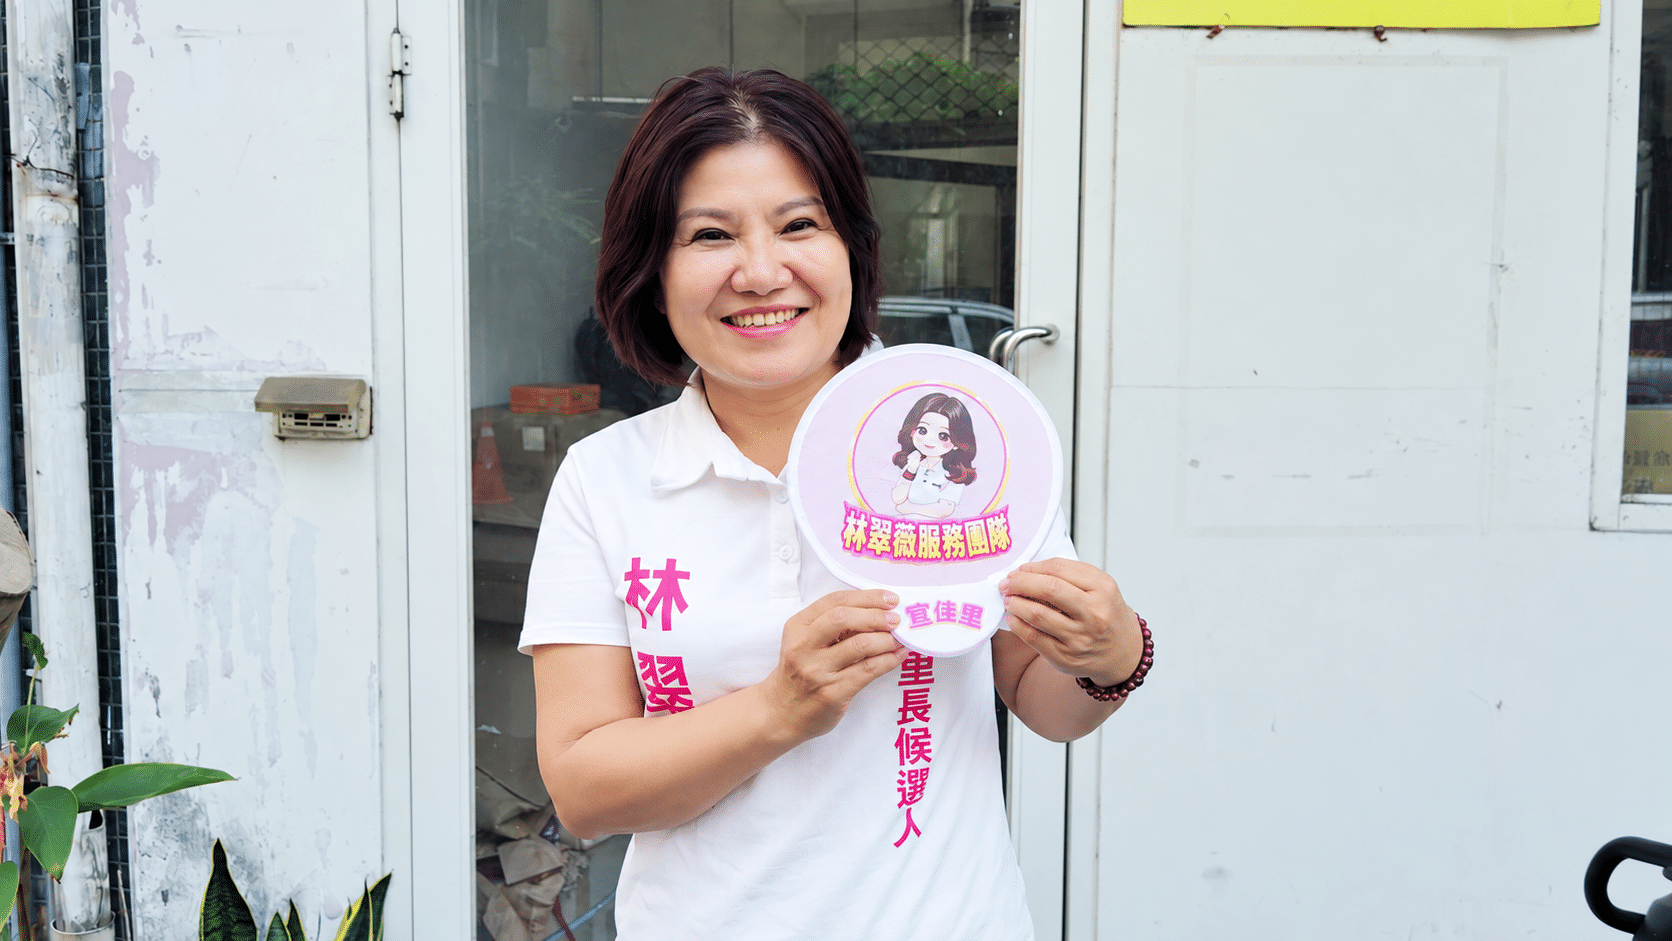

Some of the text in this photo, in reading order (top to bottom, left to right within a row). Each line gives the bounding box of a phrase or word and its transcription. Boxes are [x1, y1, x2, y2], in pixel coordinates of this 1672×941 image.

[843, 511, 1011, 560] 林翠薇服務團隊
[904, 599, 984, 630] 宜佳里
[894, 651, 935, 848] 里長候選人
